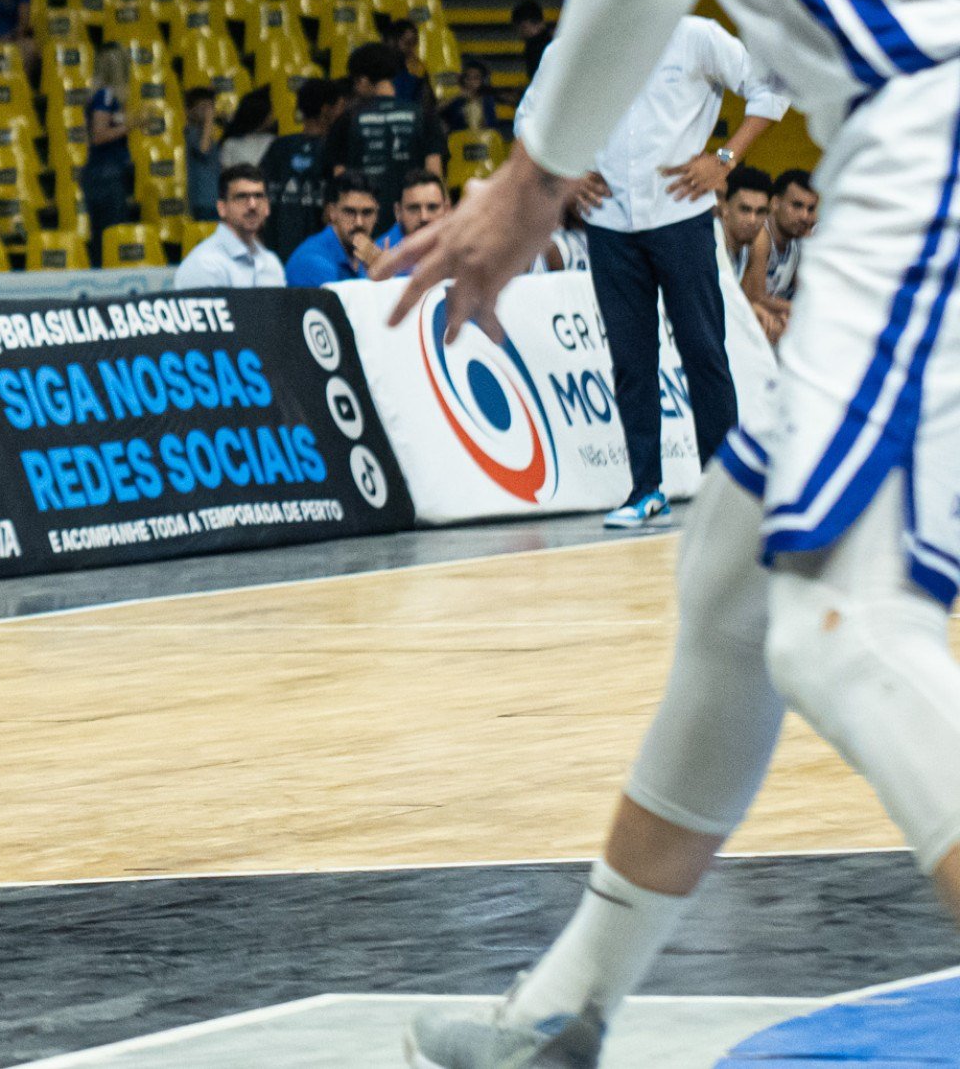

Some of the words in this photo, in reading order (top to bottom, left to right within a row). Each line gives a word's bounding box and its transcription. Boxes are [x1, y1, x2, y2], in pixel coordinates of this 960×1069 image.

[97, 348, 273, 414] NOSSAS
[20, 442, 163, 511] REDES
[159, 423, 328, 493] SOCIAIS
[48, 530, 62, 553] E
[62, 519, 151, 551] ACOMPANHE
[149, 513, 189, 540] TODA
[188, 512, 201, 532] A
[197, 503, 284, 531] TEMPORADA
[281, 501, 302, 522] DE
[300, 499, 344, 522] PERTO
